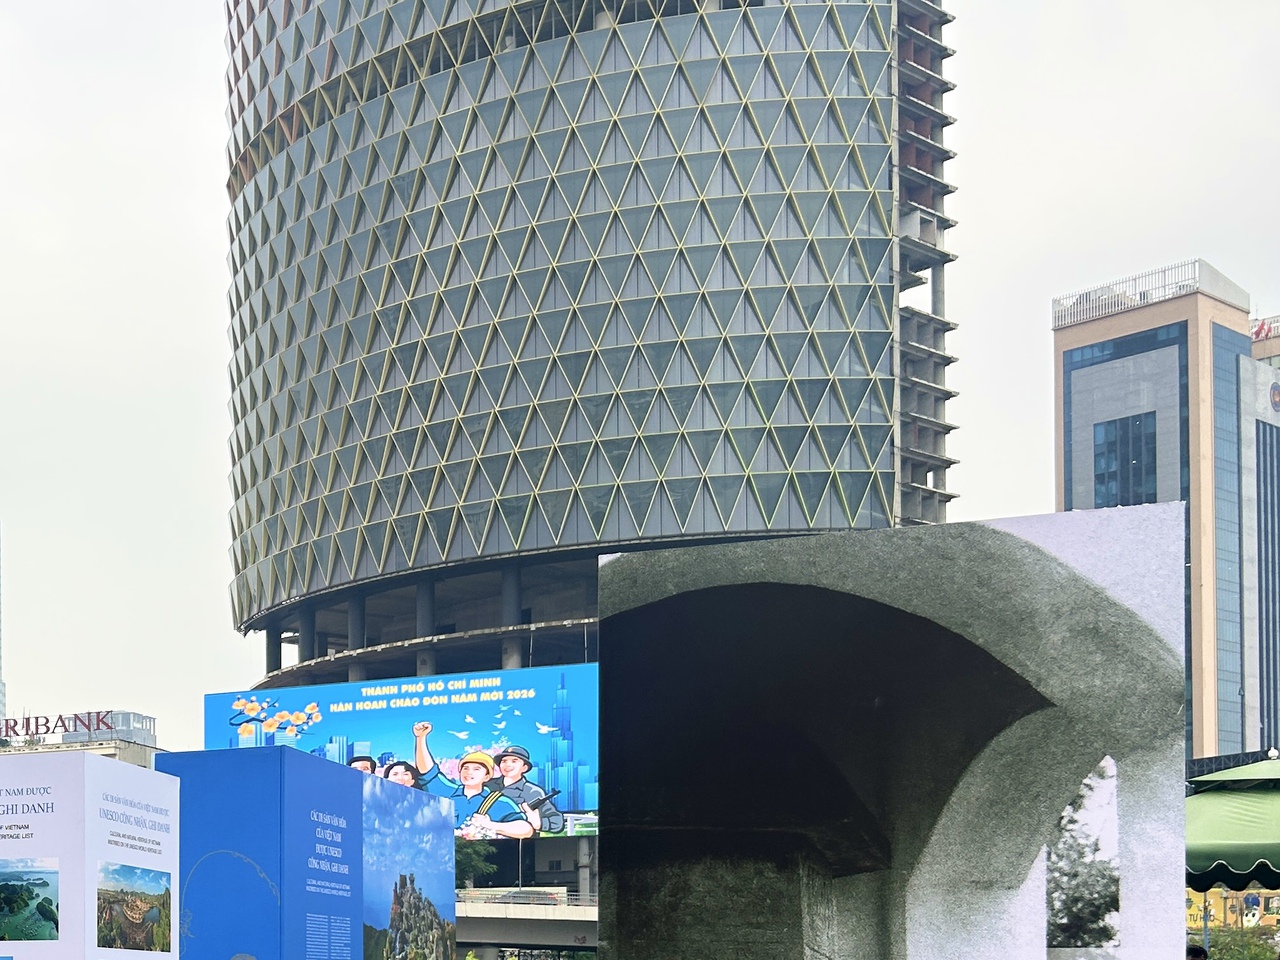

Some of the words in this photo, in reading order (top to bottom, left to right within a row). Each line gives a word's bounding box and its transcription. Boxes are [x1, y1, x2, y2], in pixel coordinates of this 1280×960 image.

[361, 685, 398, 696] THÀNH
[447, 679, 466, 690] CHÍ
[469, 677, 501, 688] MINH
[355, 700, 387, 711] HOAN
[390, 697, 420, 708] CHÀO
[422, 695, 448, 706] ĐÓN
[507, 688, 536, 700] 2026
[22, 802, 54, 814] DANH
